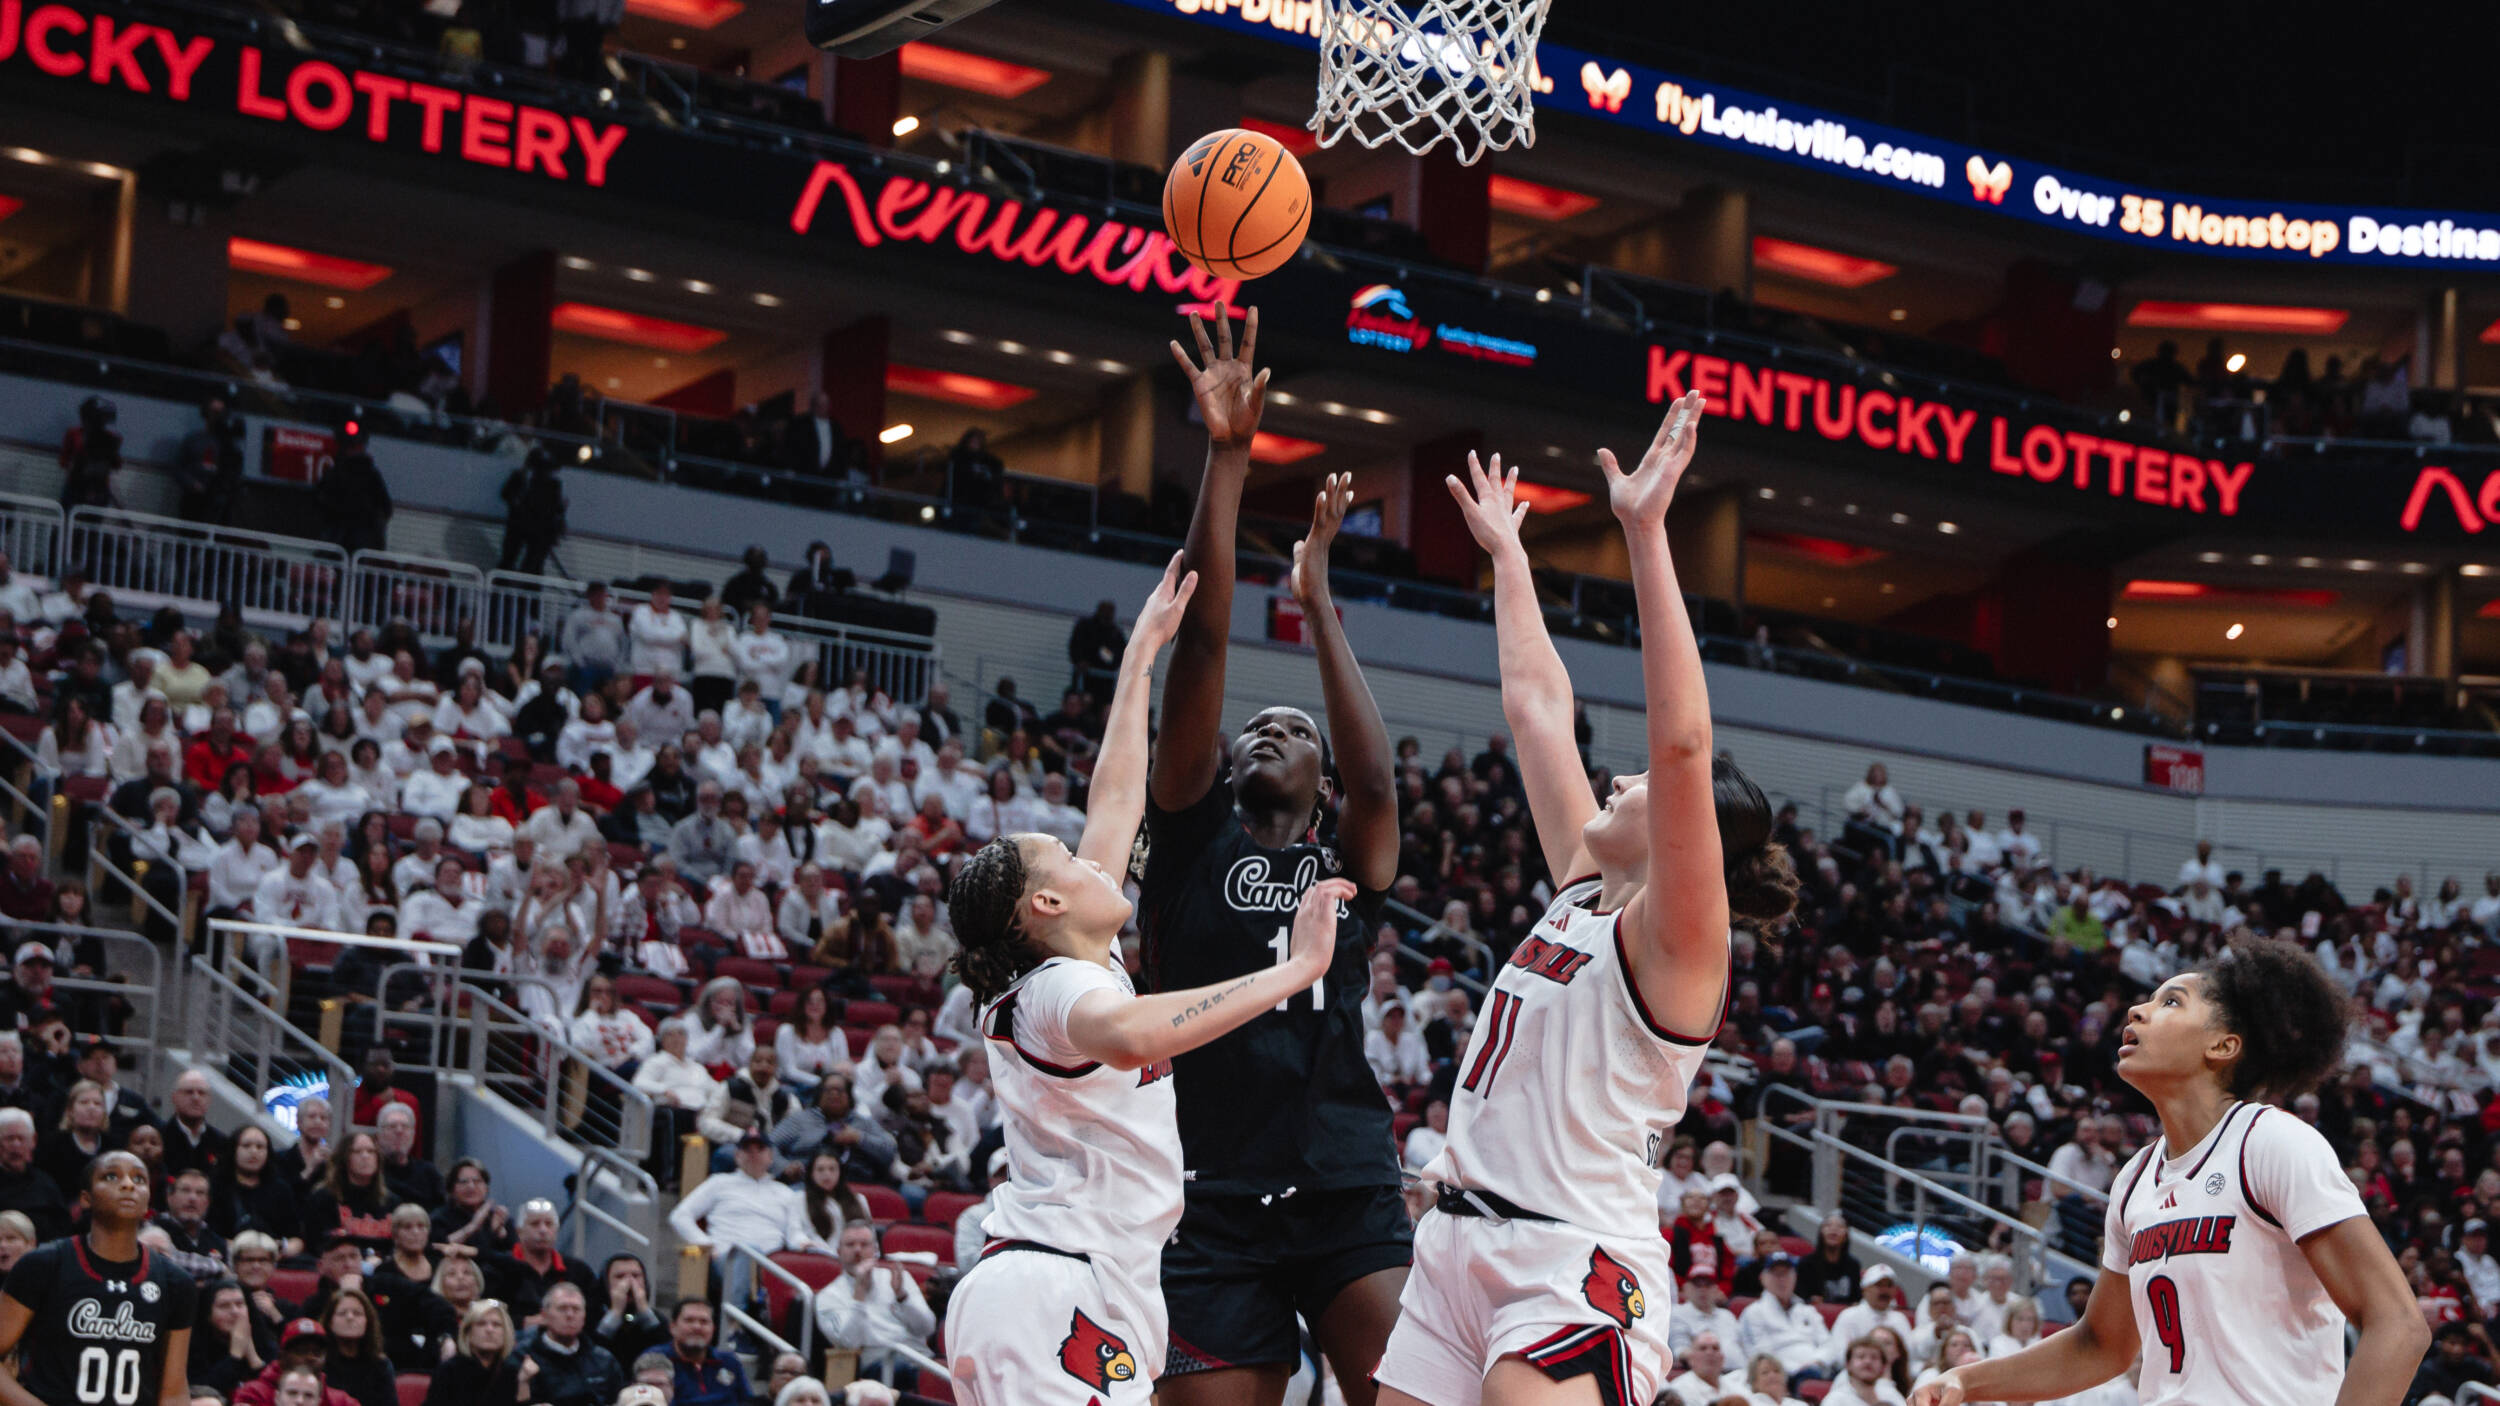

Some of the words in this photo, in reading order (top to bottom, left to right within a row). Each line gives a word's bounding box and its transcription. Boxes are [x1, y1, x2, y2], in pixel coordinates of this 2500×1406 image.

[237, 44, 629, 188] LOTTERY
[1655, 81, 1946, 189] flyLouisville.com
[1221, 142, 1257, 187] PRO
[2033, 174, 2116, 227] Over
[2120, 194, 2165, 237] 35
[2171, 202, 2340, 258] Nonstop
[1646, 344, 1978, 464] KENTUCKY
[1990, 416, 2255, 517] LOTTERY
[1461, 987, 1525, 1101] 11
[2128, 1215, 2237, 1268] OUISVILLE
[67, 1297, 157, 1343] Carolina
[2146, 1274, 2186, 1374] 9
[76, 1346, 141, 1406] 00
